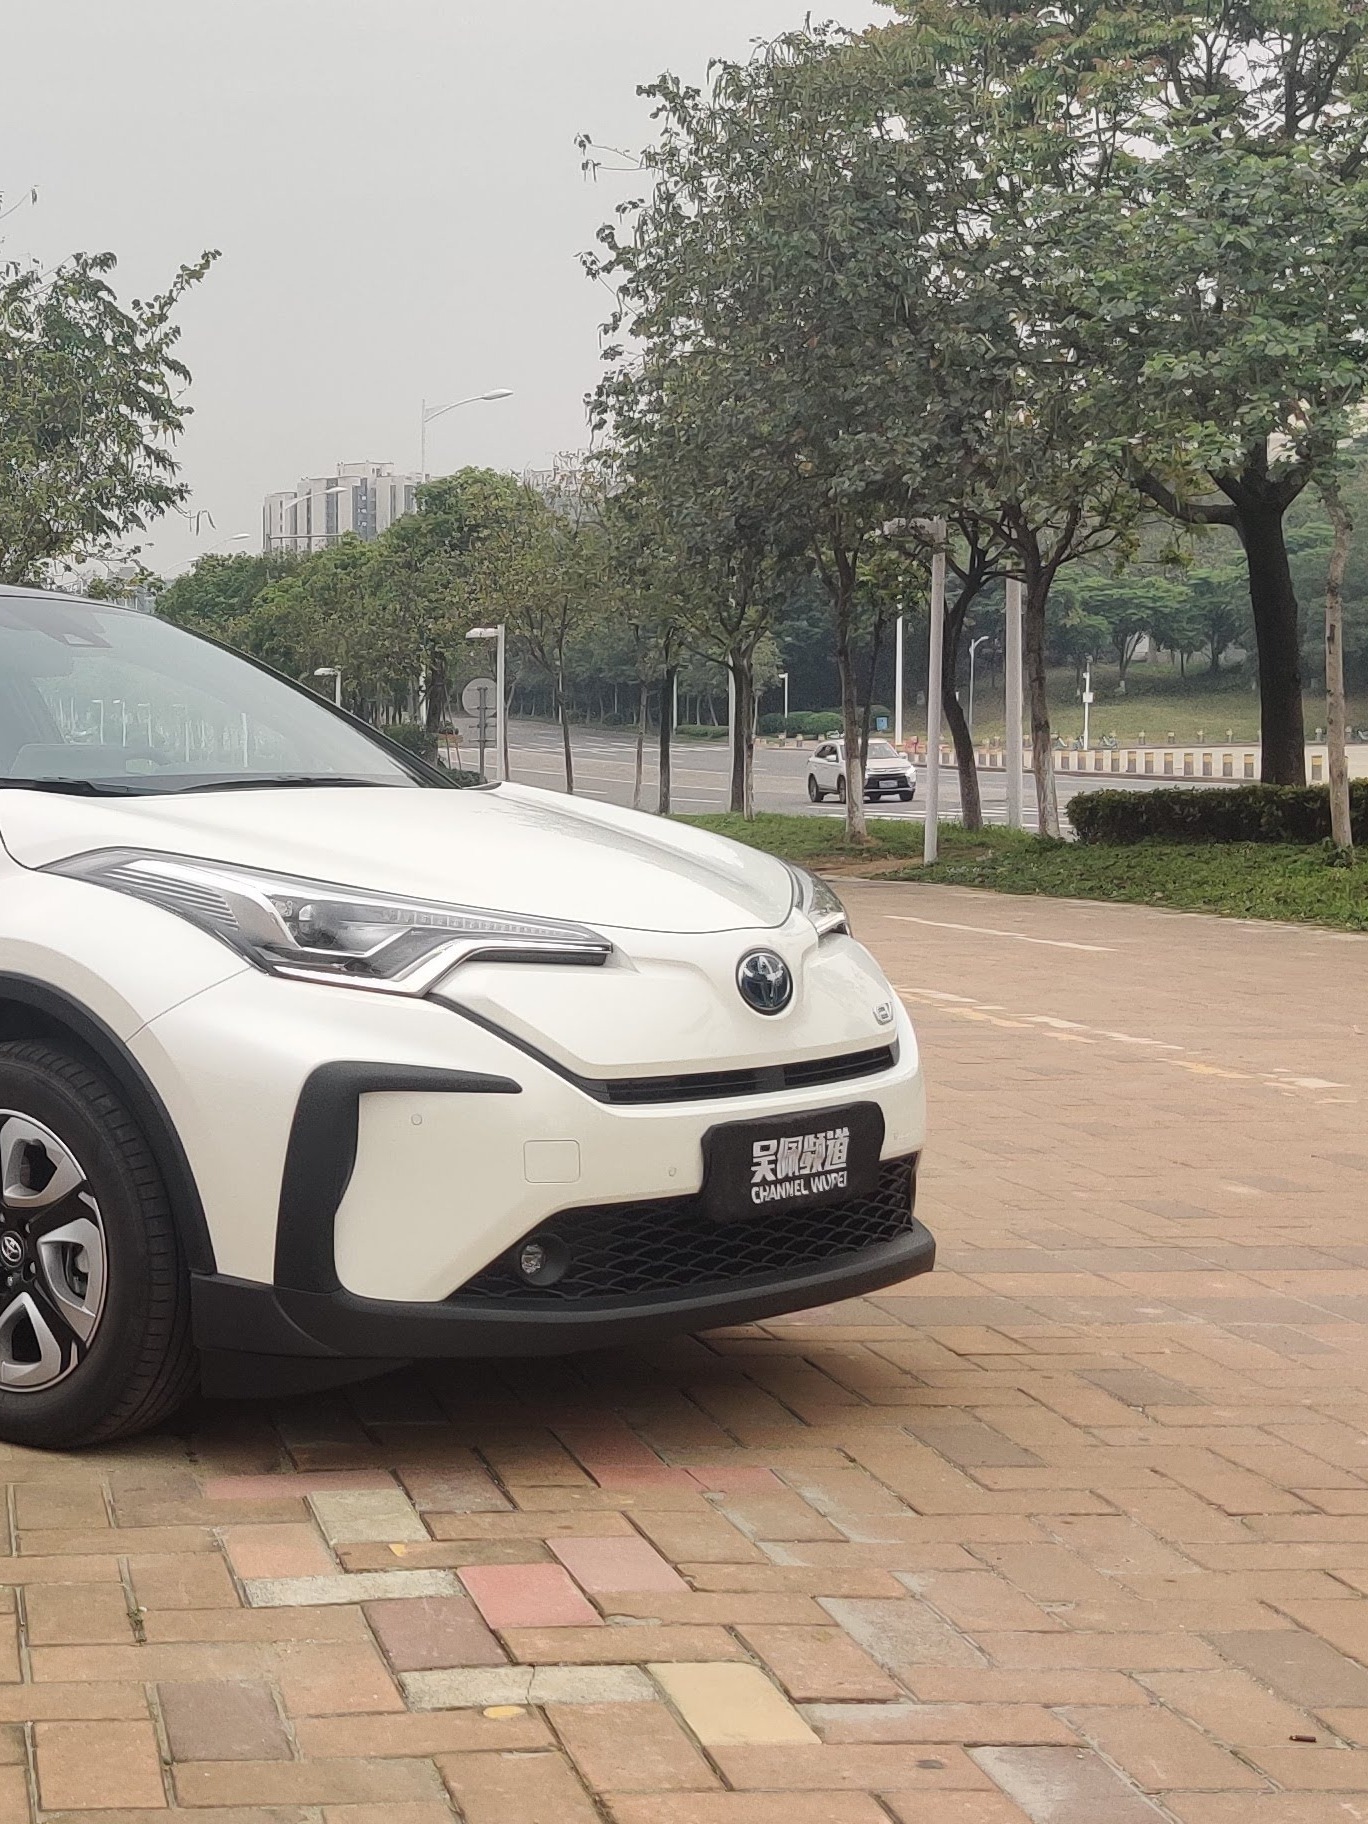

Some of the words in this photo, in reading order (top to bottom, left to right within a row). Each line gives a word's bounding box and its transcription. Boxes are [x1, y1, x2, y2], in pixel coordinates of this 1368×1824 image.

[750, 1127, 850, 1184] 吴佩频道
[751, 1178, 809, 1204] CHANNEL
[811, 1171, 848, 1193] WUPEI
